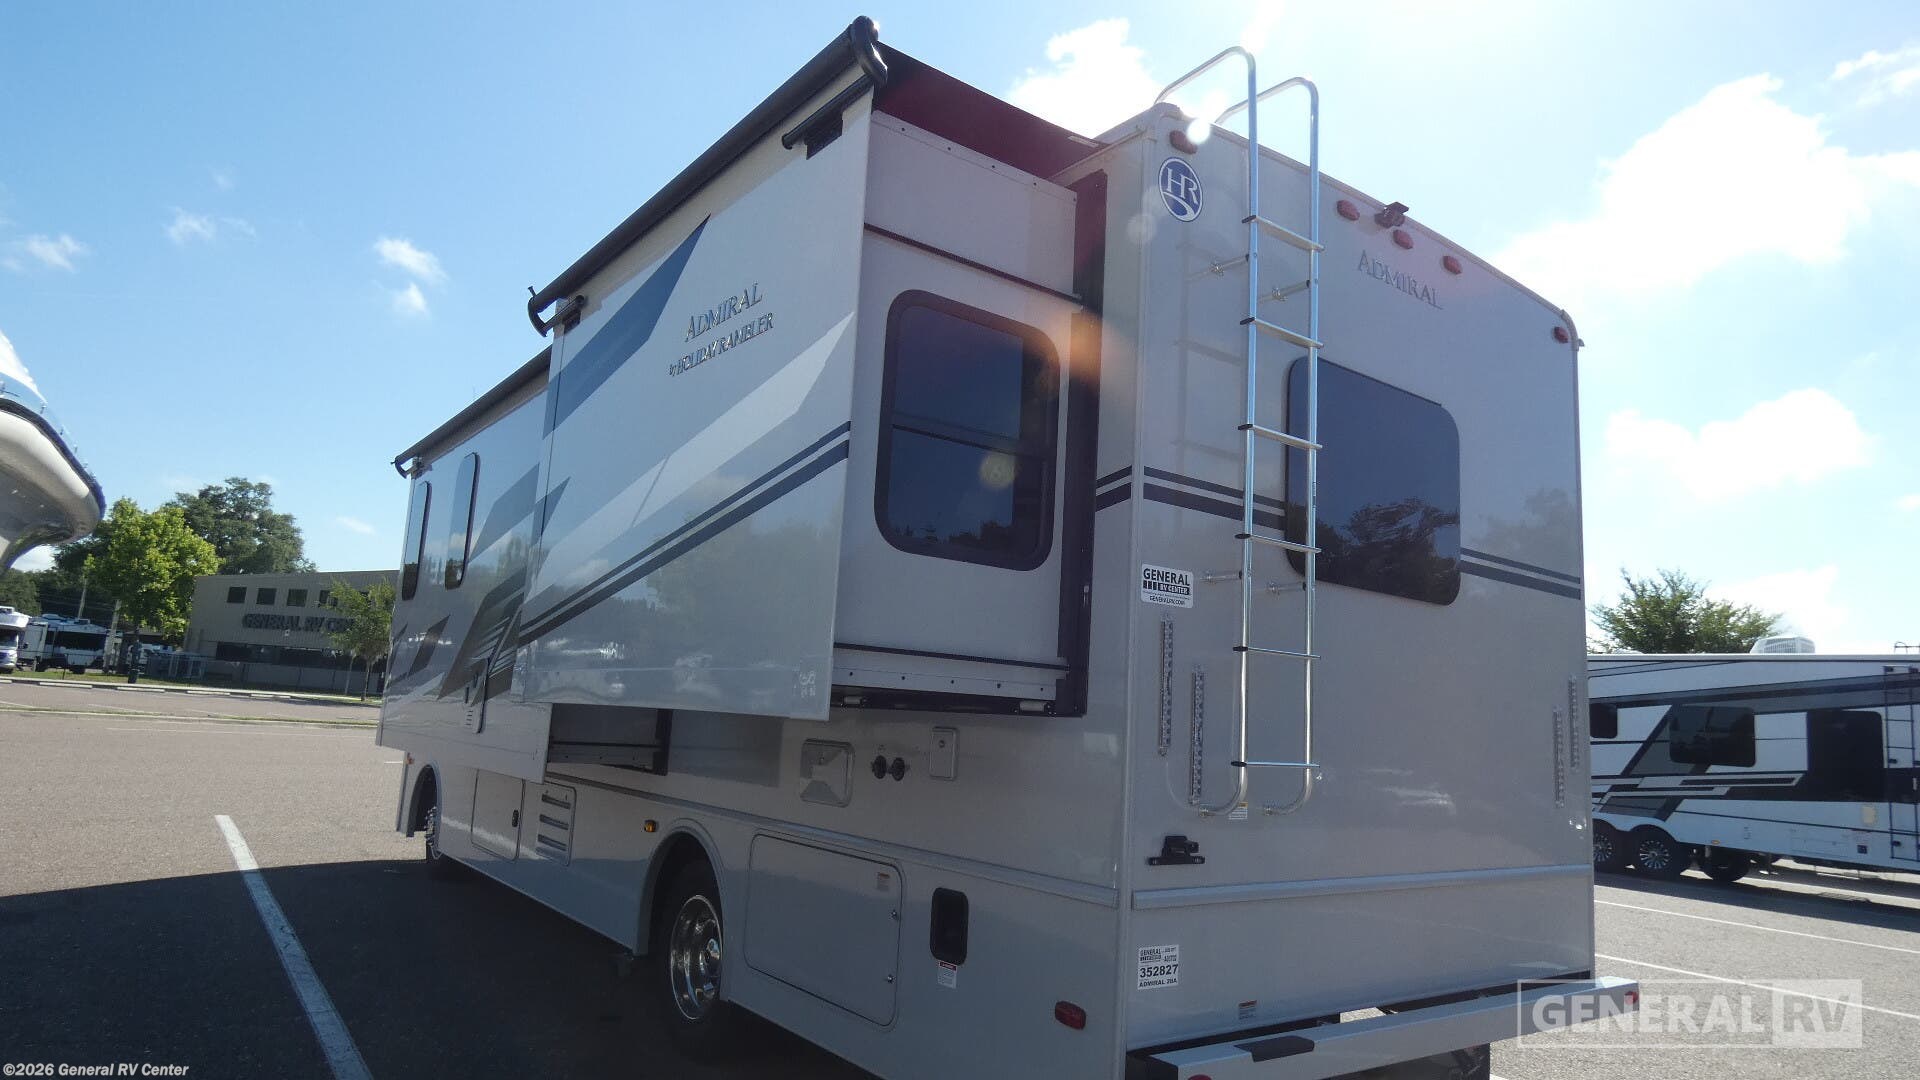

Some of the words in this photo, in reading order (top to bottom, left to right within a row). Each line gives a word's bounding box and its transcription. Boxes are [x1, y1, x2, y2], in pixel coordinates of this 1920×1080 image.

[1165, 166, 1199, 205] HR
[1357, 249, 1444, 310] ADMIRAL
[684, 282, 763, 343] ADMIRAL
[676, 340, 719, 375] HOLIDAY
[718, 312, 774, 355] RAMBLER
[1143, 567, 1190, 587] GENERAL
[242, 613, 301, 631] GENERAL
[304, 616, 325, 632] RV
[1139, 980, 1166, 988] ADMIRAL
[1140, 964, 1178, 978] 352827
